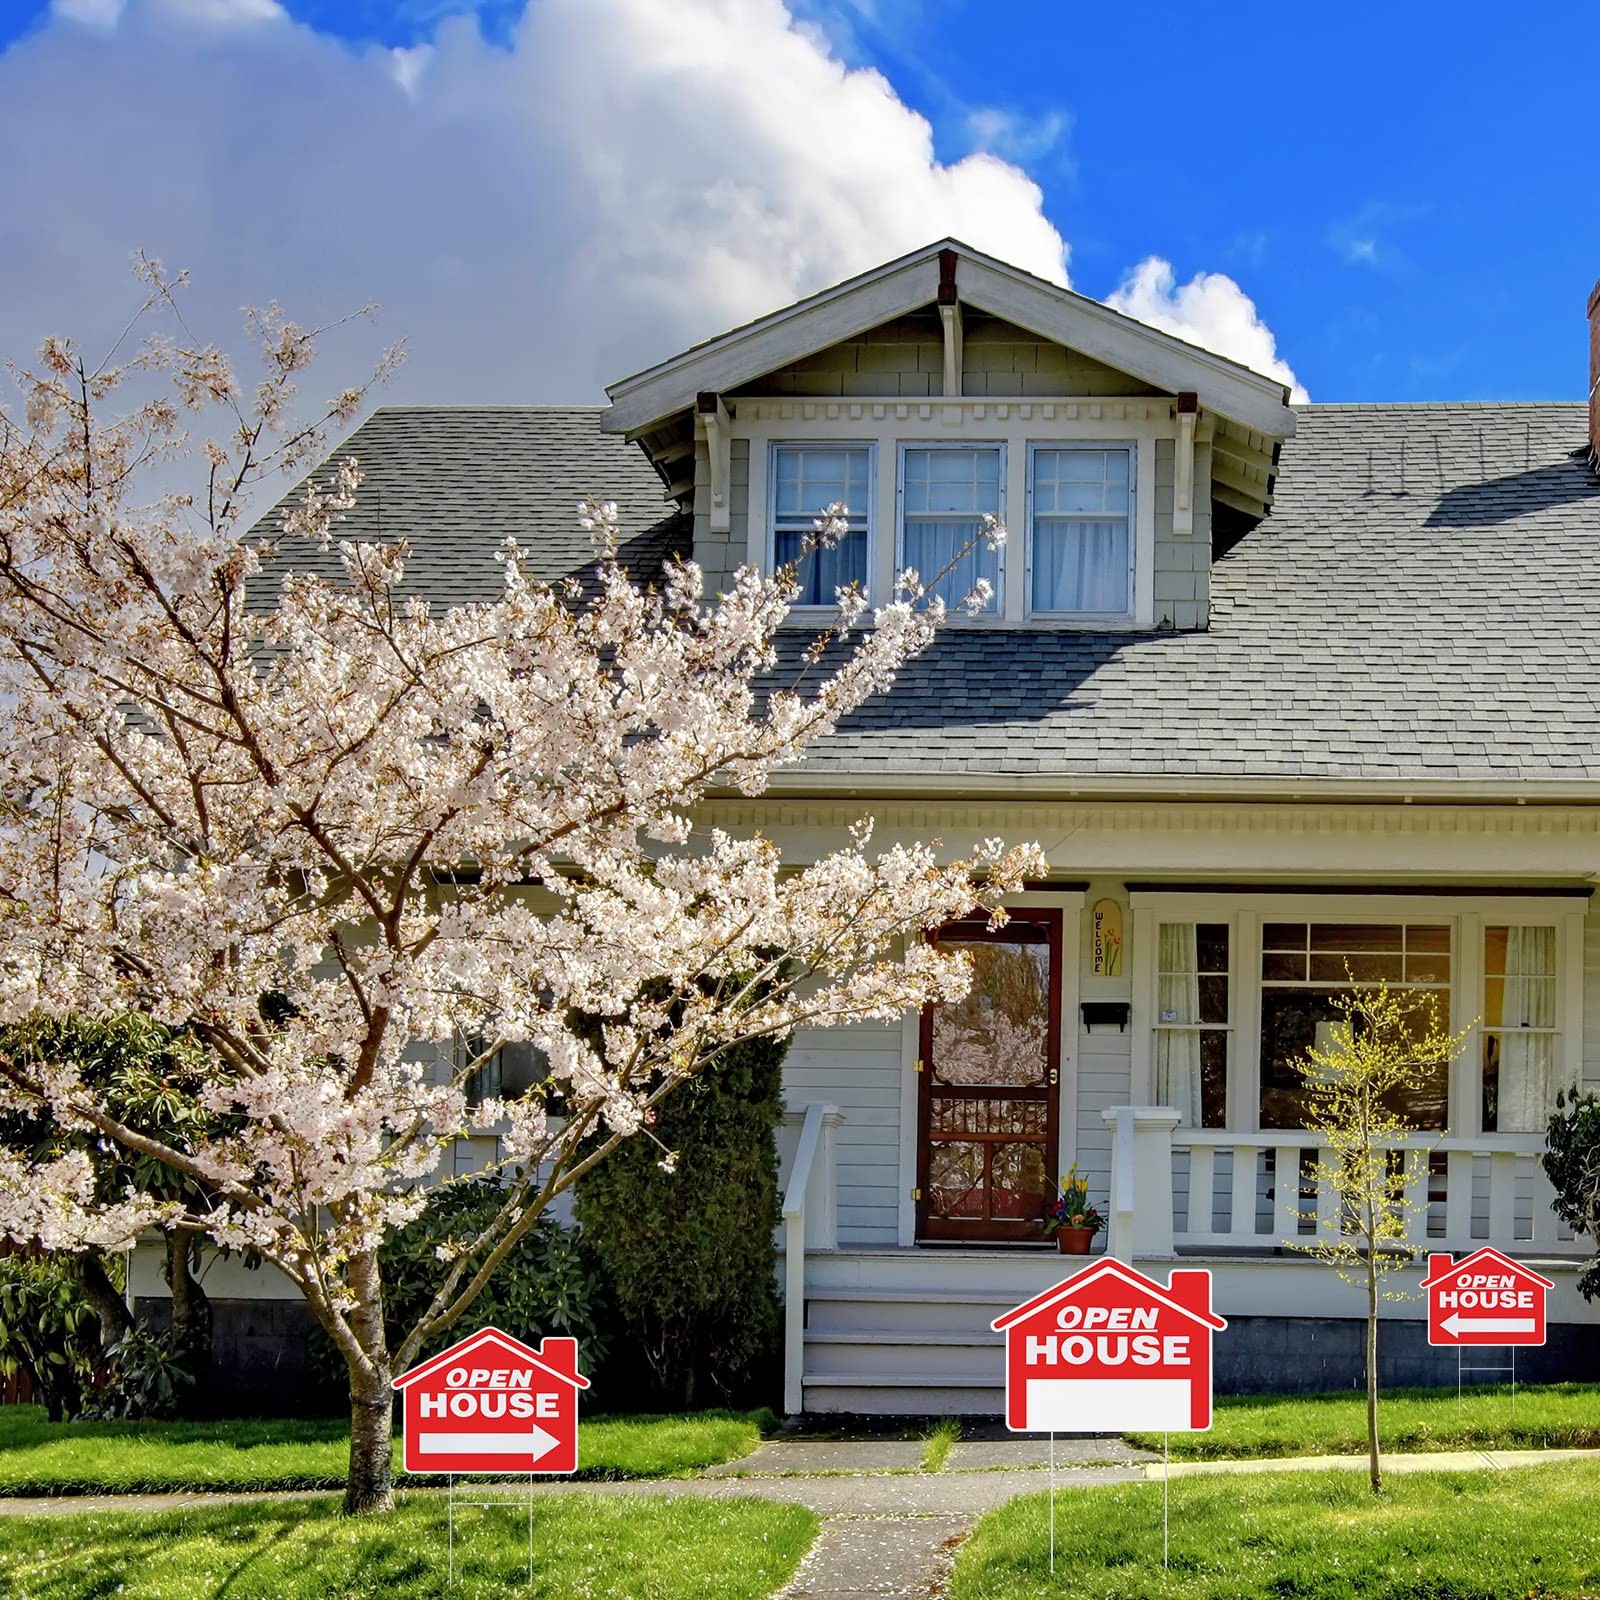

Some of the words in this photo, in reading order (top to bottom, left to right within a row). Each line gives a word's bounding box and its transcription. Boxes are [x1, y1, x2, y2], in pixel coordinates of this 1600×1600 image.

[1094, 912, 1104, 972] WELCOME
[1456, 1273, 1516, 1288] OPEN
[1439, 1290, 1534, 1309] HOUSE
[1056, 1305, 1160, 1329] OPEN
[1025, 1335, 1191, 1366] HOUSE
[445, 1367, 533, 1388] OPEN
[419, 1392, 560, 1418] HOUSE
